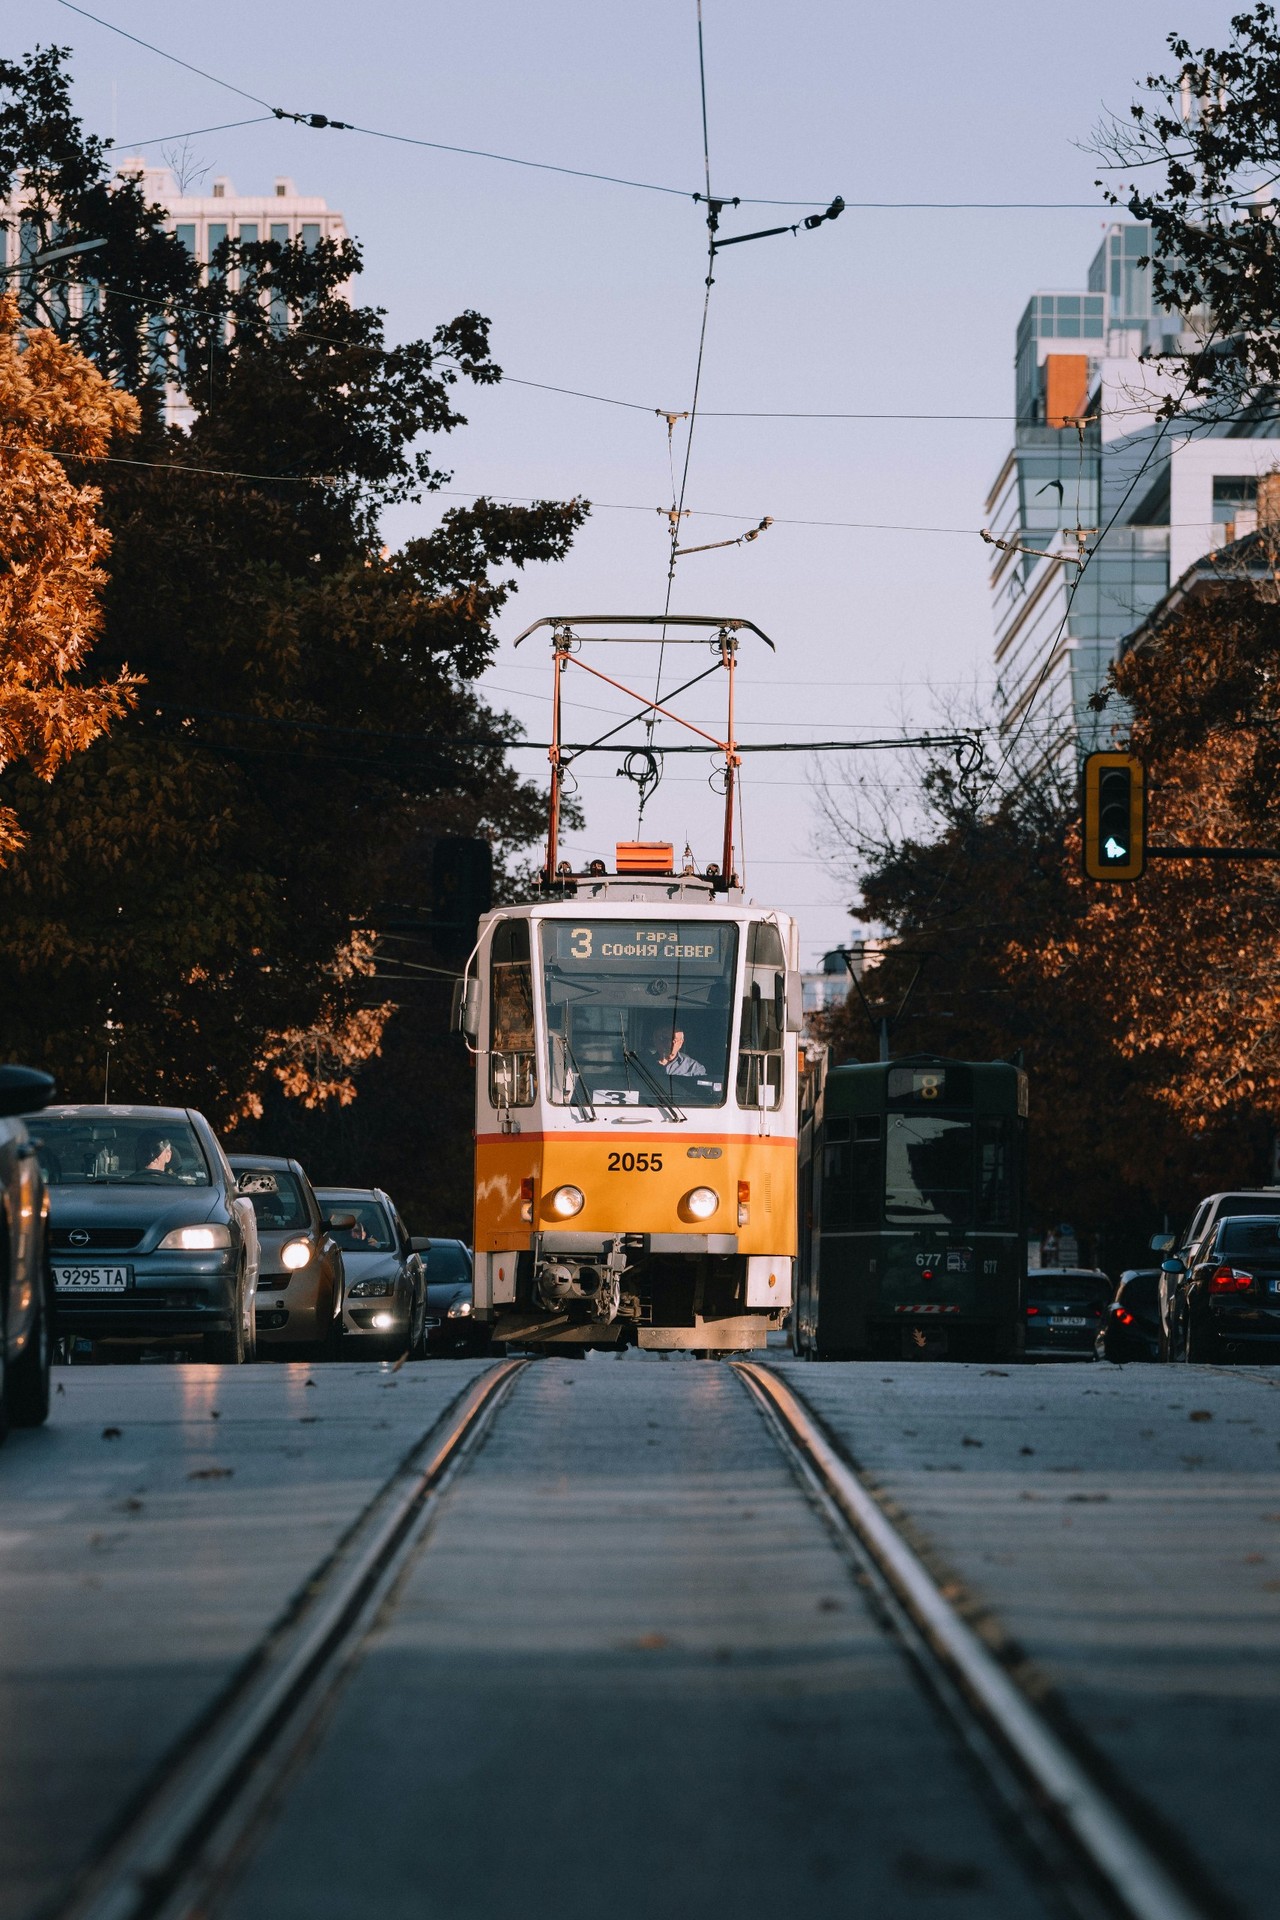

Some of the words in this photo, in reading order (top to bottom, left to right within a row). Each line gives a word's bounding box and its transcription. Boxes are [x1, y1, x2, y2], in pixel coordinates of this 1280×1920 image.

[571, 928, 592, 959] 3
[636, 932, 678, 942] гара
[602, 943, 657, 957] СОФИЯ
[664, 945, 714, 958] СЕВЕР
[922, 1074, 938, 1100] 8
[607, 1152, 663, 1172] 2055
[915, 1253, 941, 1266] 677
[62, 1269, 100, 1285] 9295
[103, 1269, 124, 1285] TA
